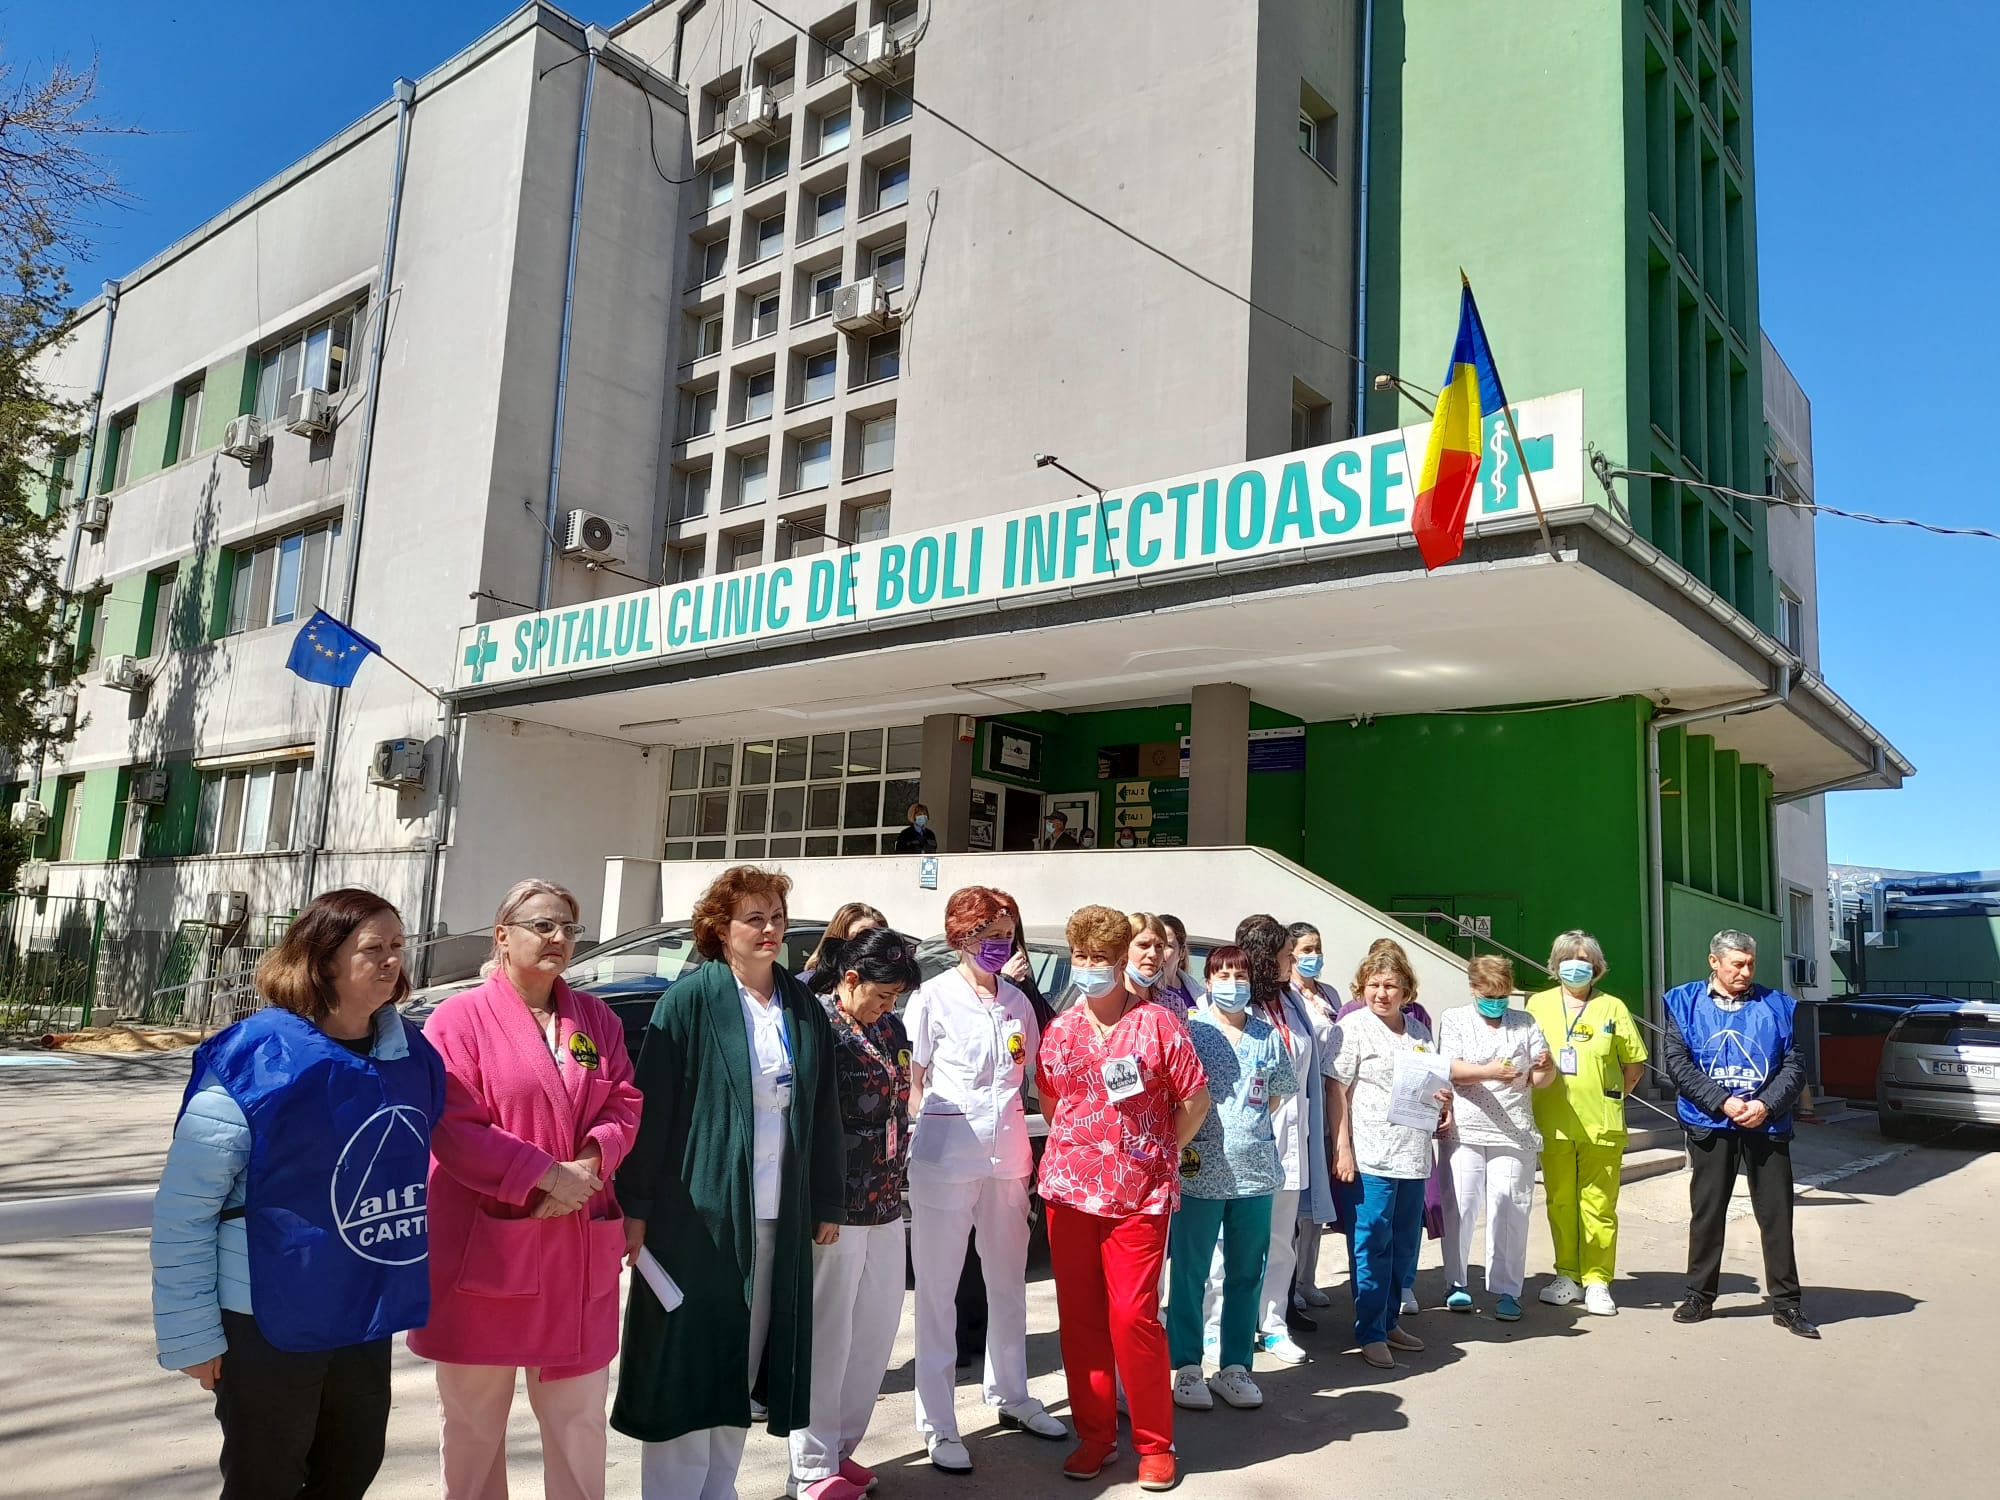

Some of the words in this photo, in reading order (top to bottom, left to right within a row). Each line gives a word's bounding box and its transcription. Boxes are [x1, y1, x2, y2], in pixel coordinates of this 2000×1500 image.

[512, 597, 654, 673] SPITALUL
[667, 567, 793, 646] CLINIC
[806, 551, 861, 622] DE
[876, 527, 984, 611] BOLI
[1002, 439, 1406, 590] INFECTIOASE
[1940, 1064, 1953, 1072] CT
[1957, 1065, 1969, 1073] 80
[1970, 1066, 1992, 1074] SMS
[359, 1183, 425, 1217] alf
[359, 1215, 428, 1247] CART
